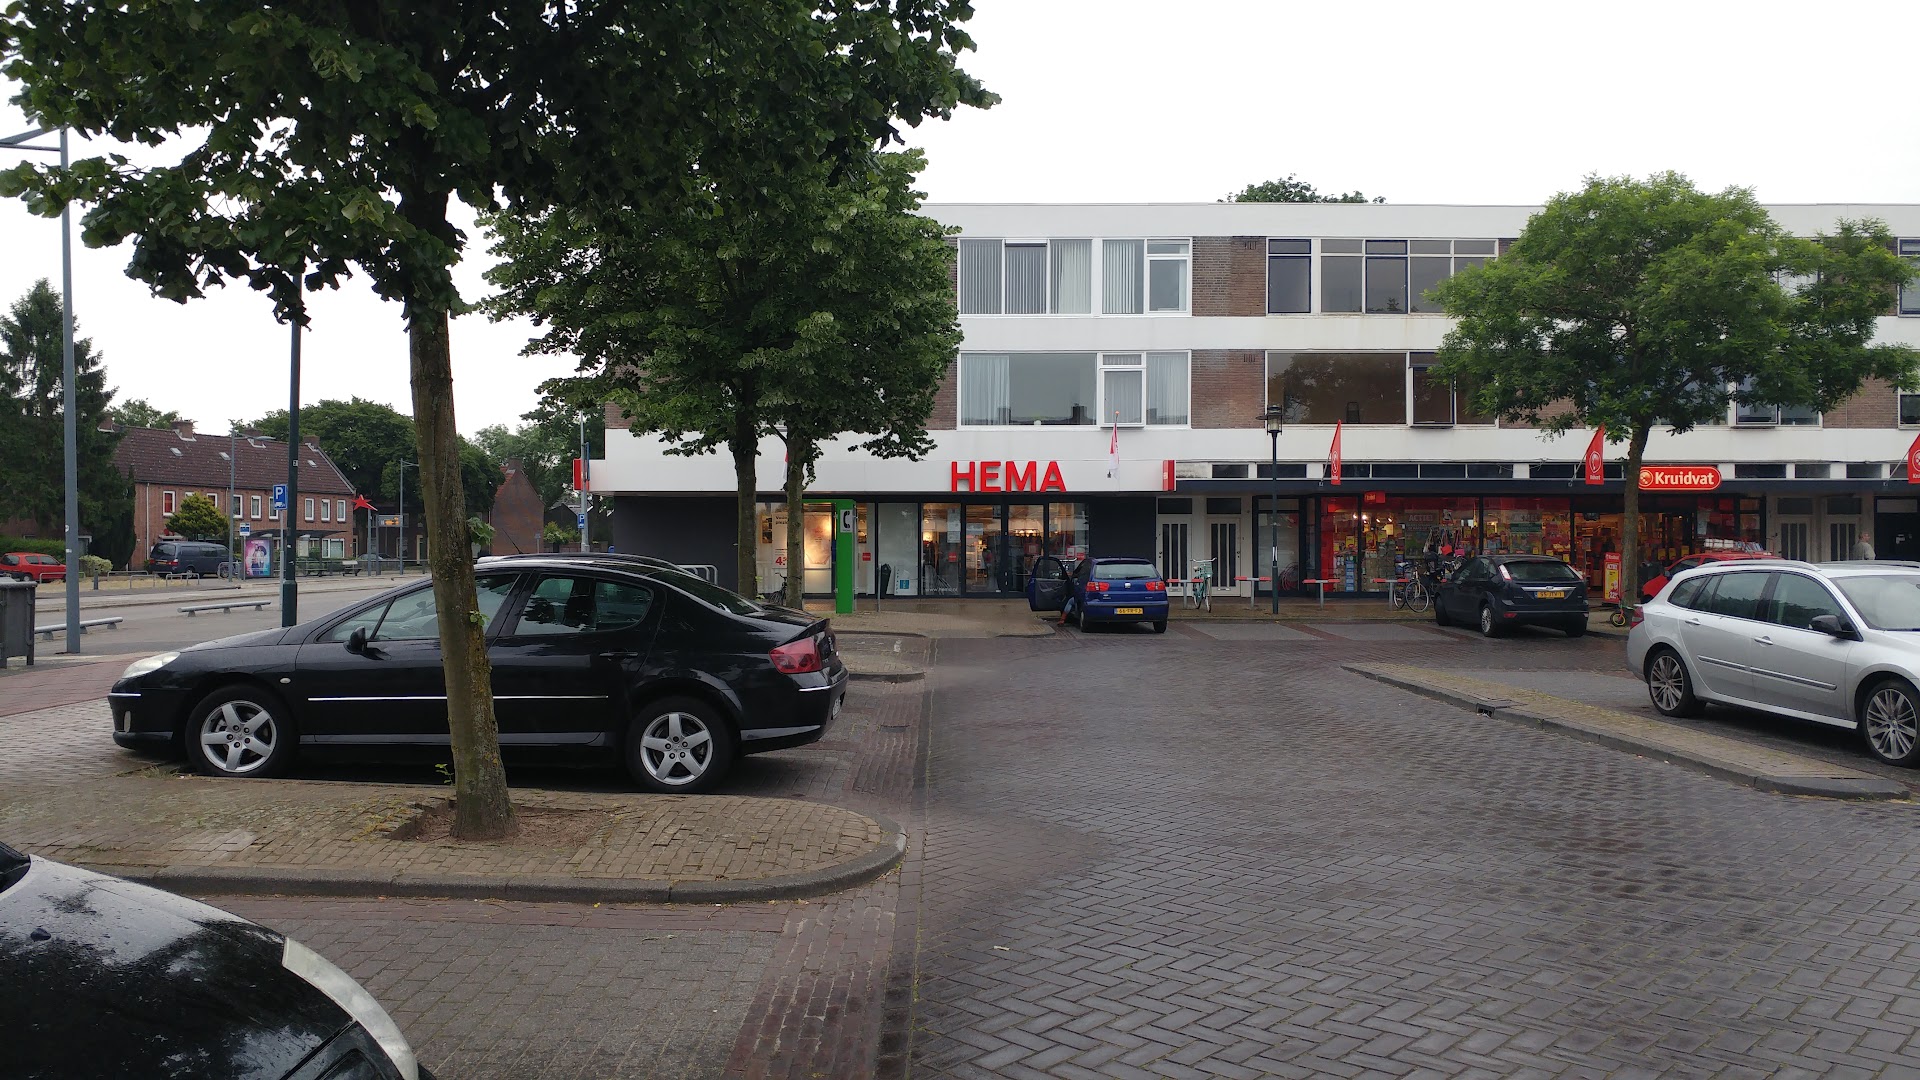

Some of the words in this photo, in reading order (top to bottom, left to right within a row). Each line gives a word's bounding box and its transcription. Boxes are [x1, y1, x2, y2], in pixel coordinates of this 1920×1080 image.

[951, 460, 1067, 493] HEMA
[1654, 471, 1715, 485] Kruidvat
[275, 487, 283, 500] P
